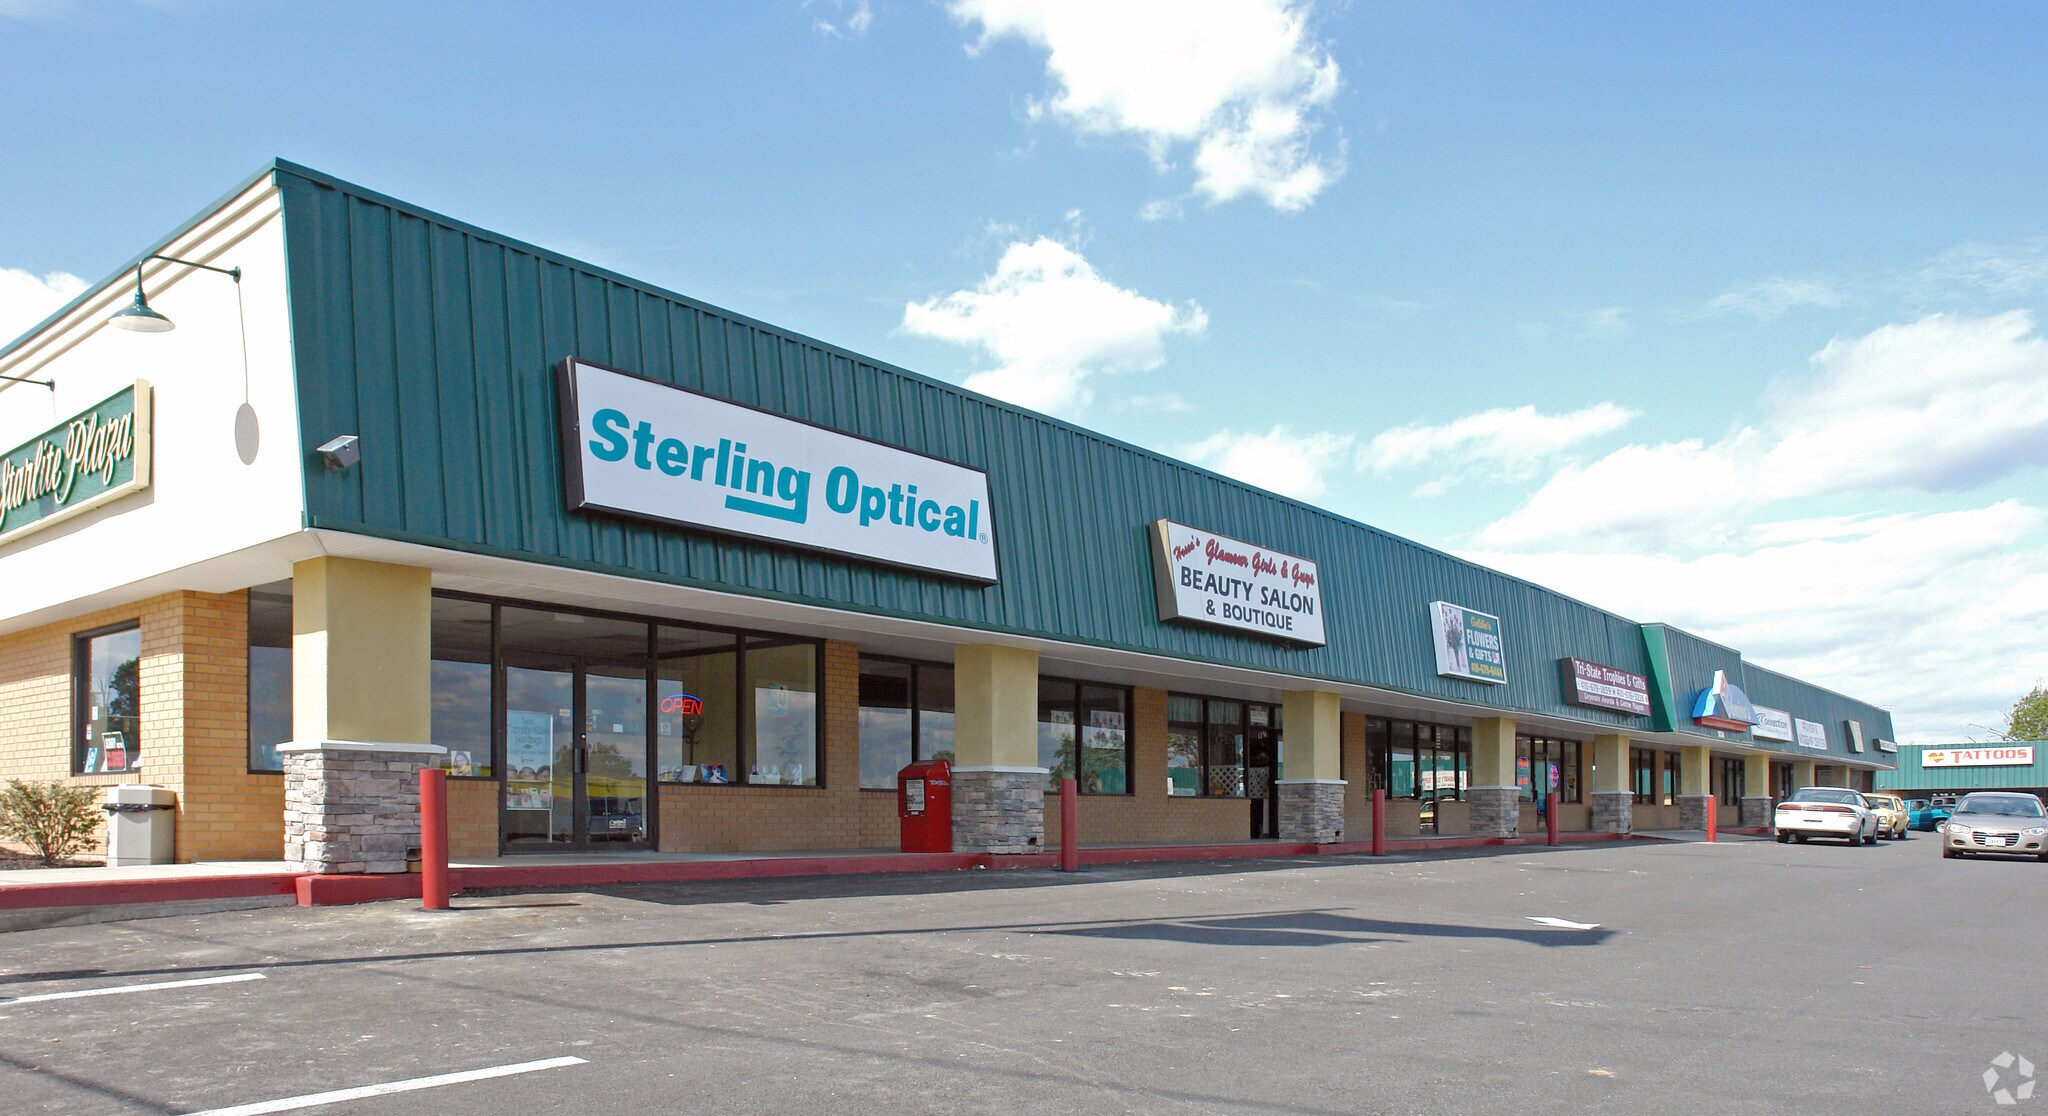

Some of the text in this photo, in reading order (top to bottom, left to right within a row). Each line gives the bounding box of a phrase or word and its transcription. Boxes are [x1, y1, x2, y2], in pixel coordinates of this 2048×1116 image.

[54, 412, 134, 504] Plaza
[588, 408, 811, 525] Sterling
[1205, 538, 1249, 568] Glamour
[1252, 552, 1277, 578] Girls
[1281, 560, 1288, 579] &
[1292, 563, 1315, 590] Guys
[1181, 565, 1314, 615] BEAUTY SALON
[1206, 599, 1293, 631] & BOUTIQUE
[1467, 629, 1498, 650] FLOWERS
[1468, 647, 1492, 662] & GIFTS
[1575, 661, 1646, 690] Tri-State Trophies & Gifts
[660, 697, 704, 717] OPEN
[1951, 749, 2028, 763] TATTOOS
